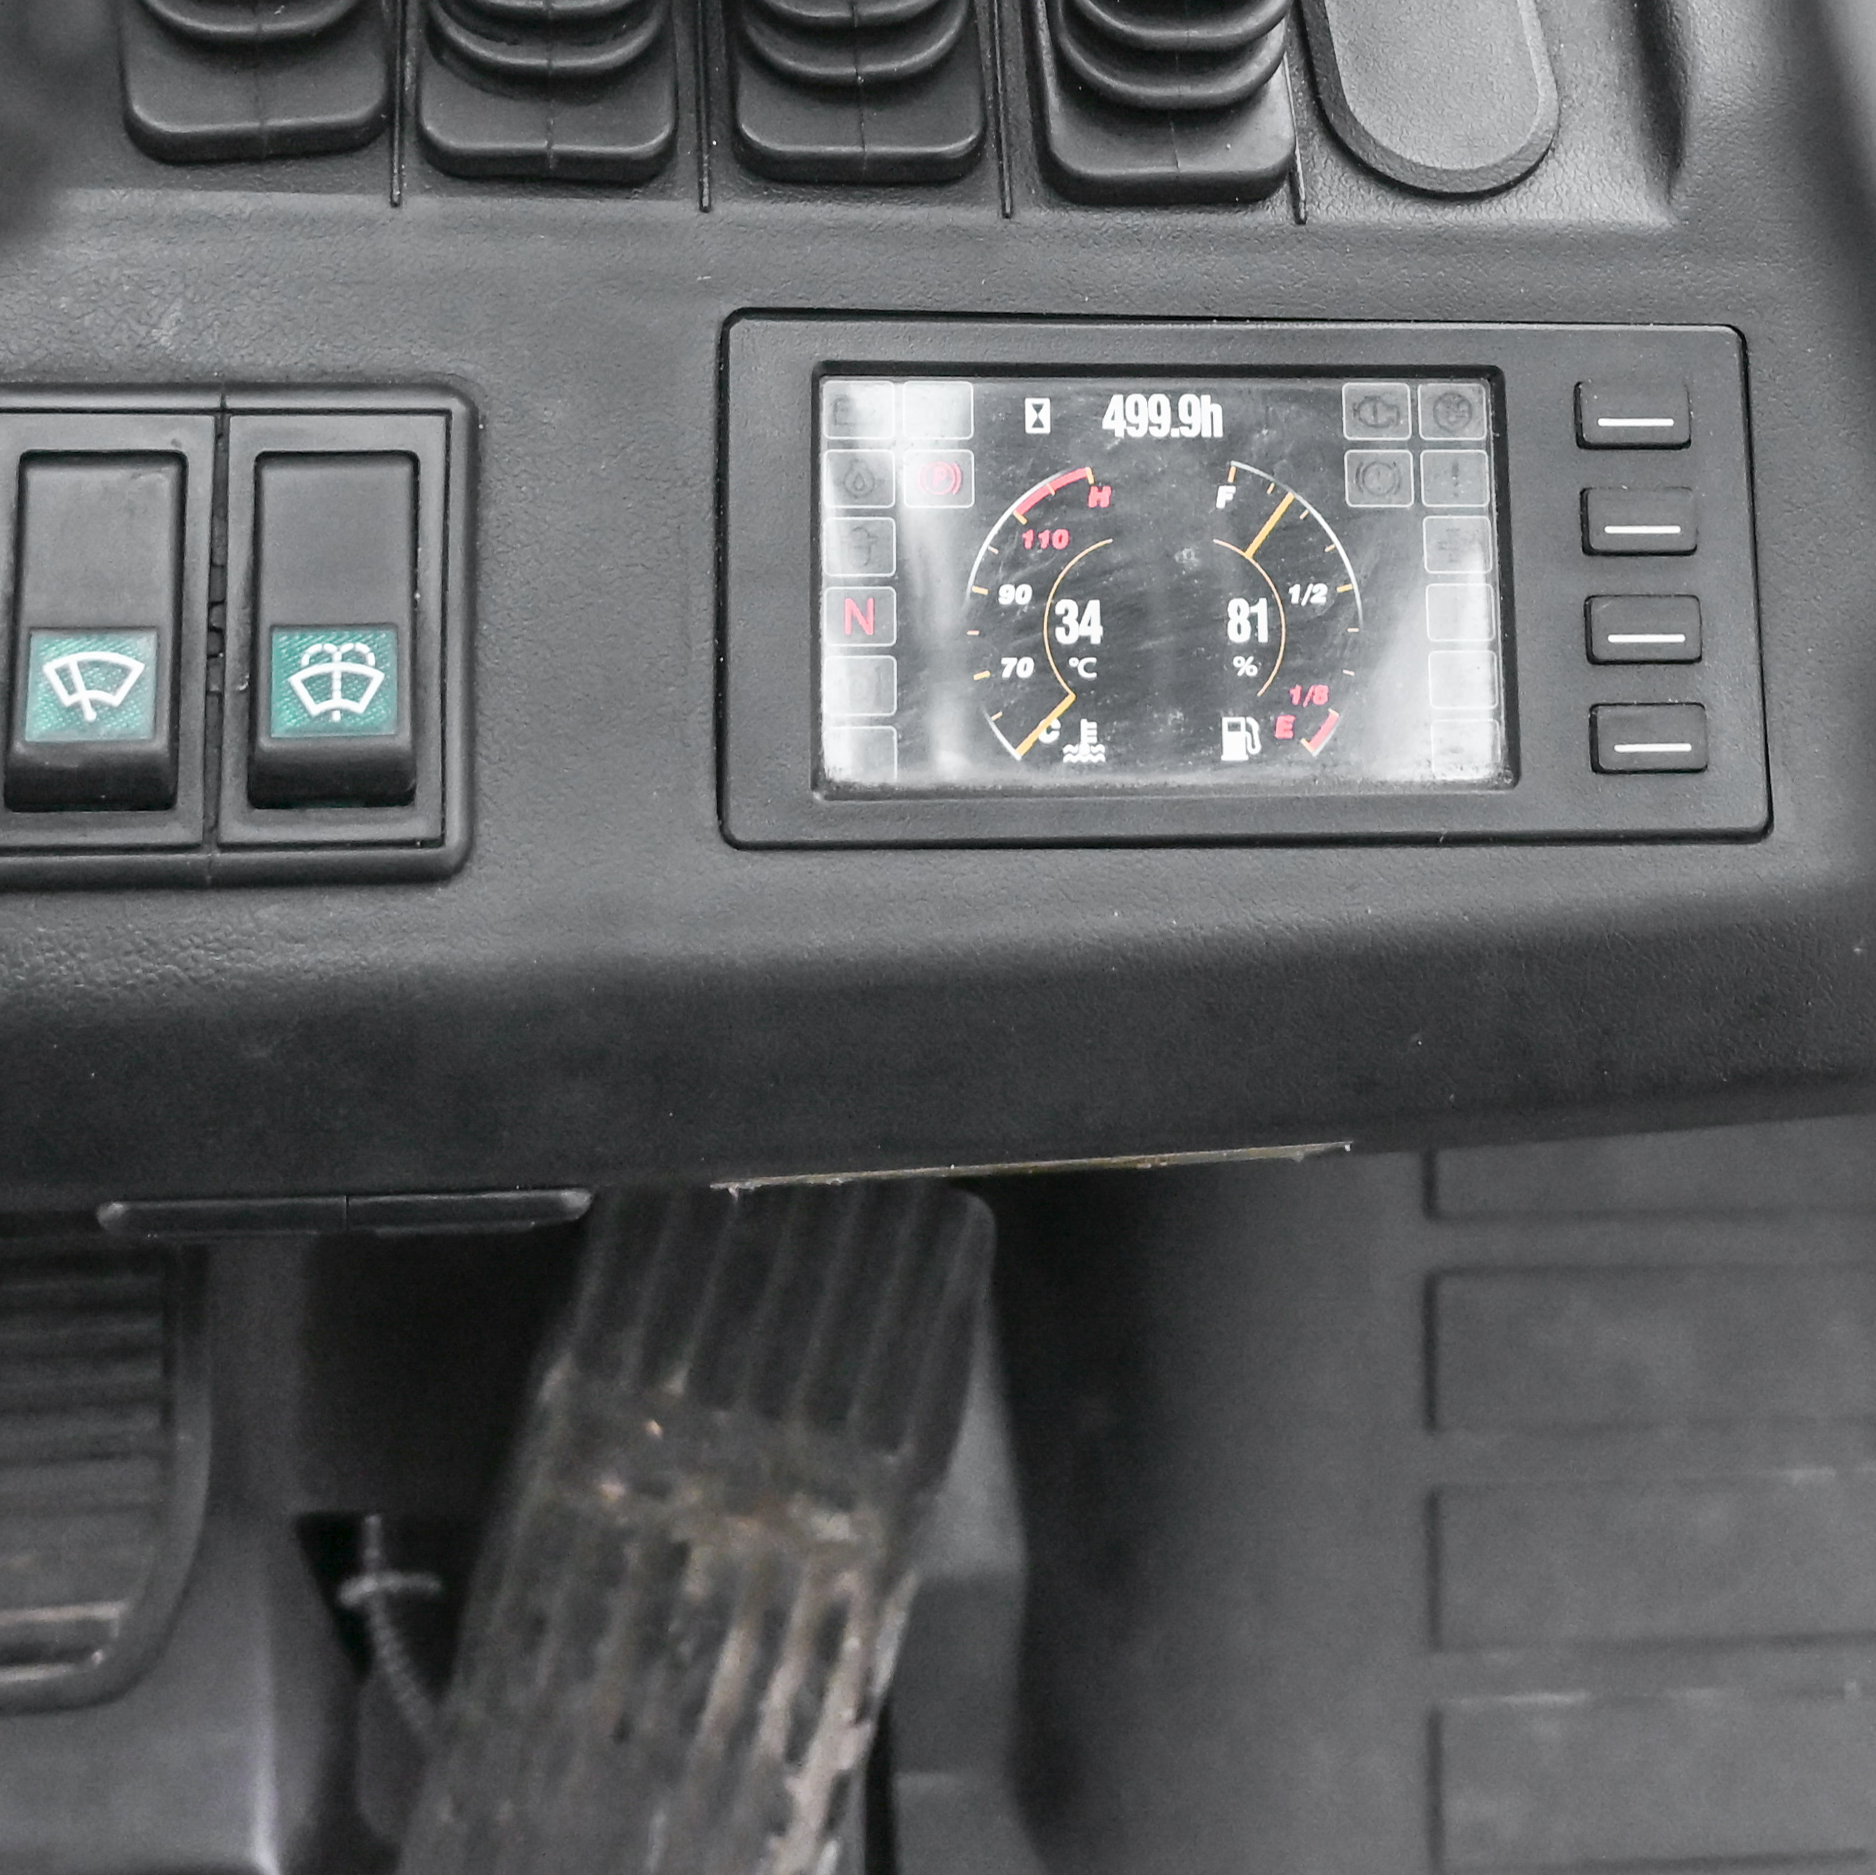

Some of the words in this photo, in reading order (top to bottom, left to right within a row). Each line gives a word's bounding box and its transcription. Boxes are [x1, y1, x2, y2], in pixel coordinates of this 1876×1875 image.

[1101, 393, 1224, 438] 499.9h
[1087, 485, 1112, 508] H
[1216, 485, 1237, 509] F
[1022, 528, 1070, 550] 110
[998, 584, 1033, 605] 90
[1288, 583, 1329, 607] 1/2
[844, 597, 875, 635] N
[1054, 598, 1104, 645] 34
[1227, 597, 1269, 643] 81
[1001, 657, 1035, 679] 70
[1233, 655, 1258, 677] %
[1289, 684, 1330, 707] 1/8
[1038, 718, 1062, 744] C
[1275, 714, 1296, 740] E
